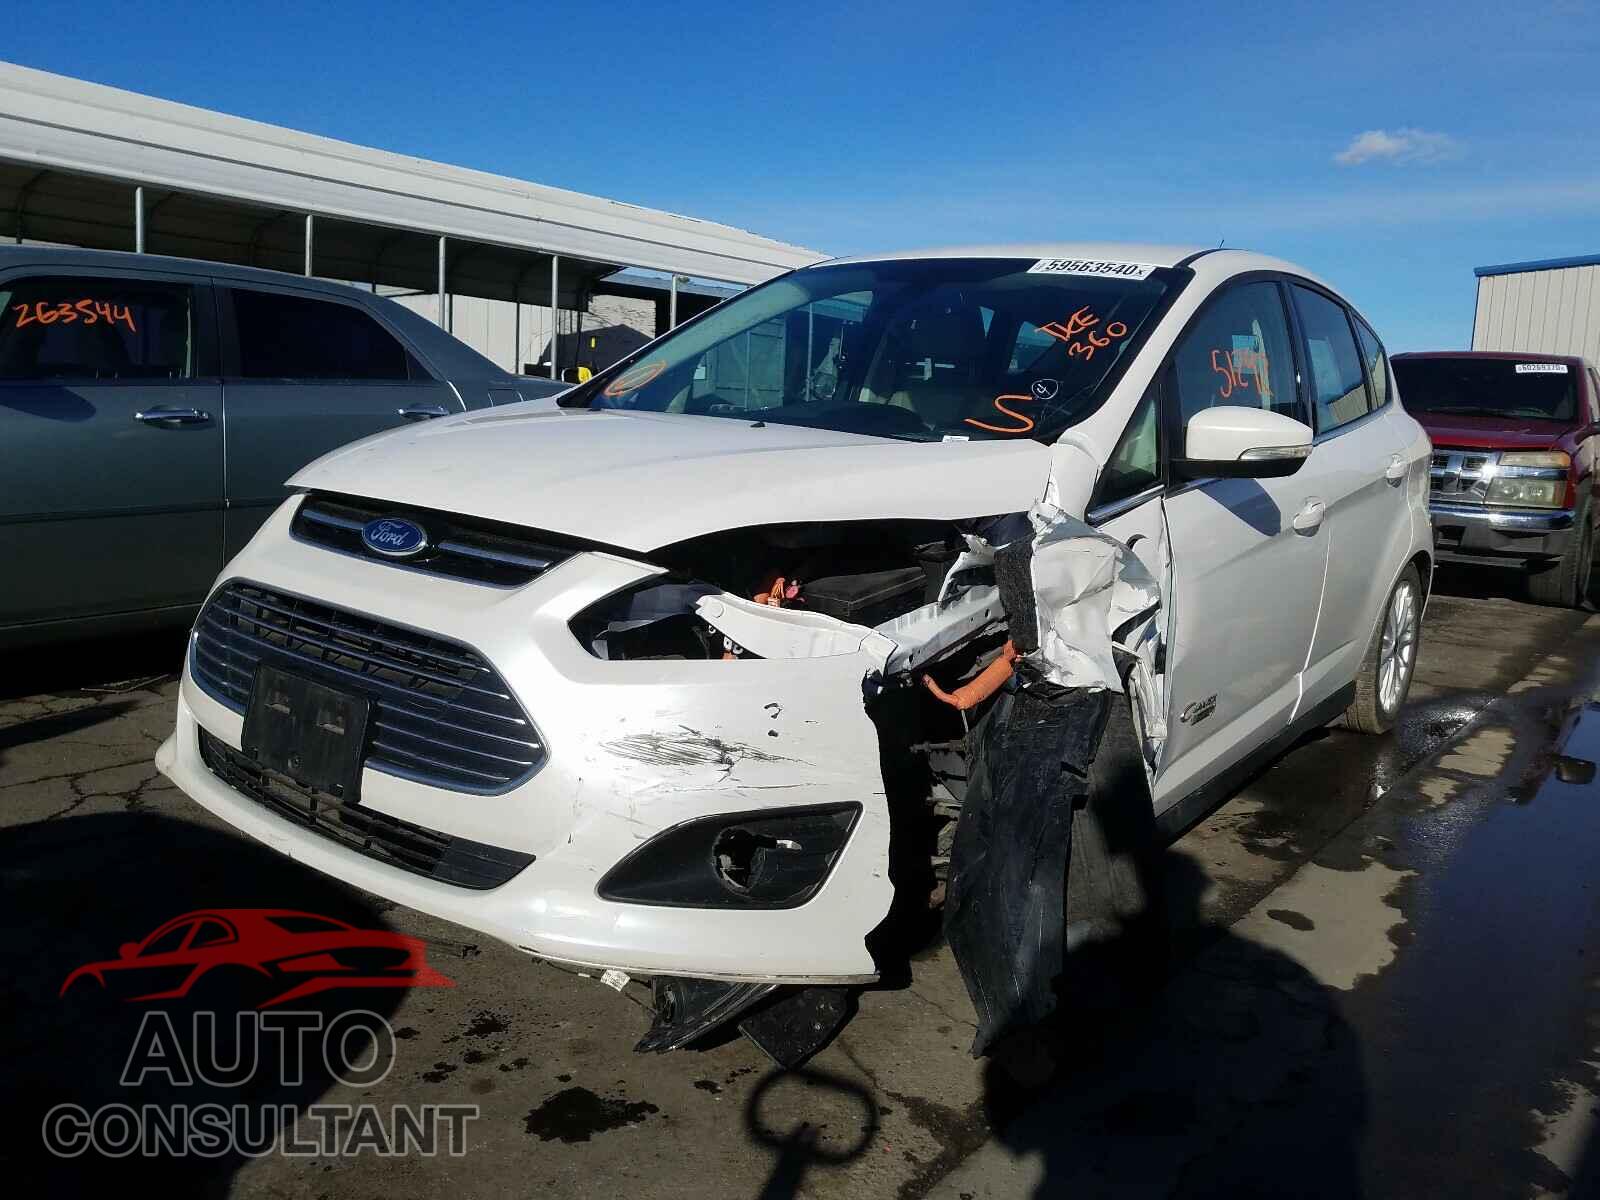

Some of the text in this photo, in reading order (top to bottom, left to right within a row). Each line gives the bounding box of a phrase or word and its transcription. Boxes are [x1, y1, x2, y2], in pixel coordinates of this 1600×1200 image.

[13, 299, 137, 332] 263544
[1069, 321, 1127, 360] 360
[370, 520, 411, 546] Ford
